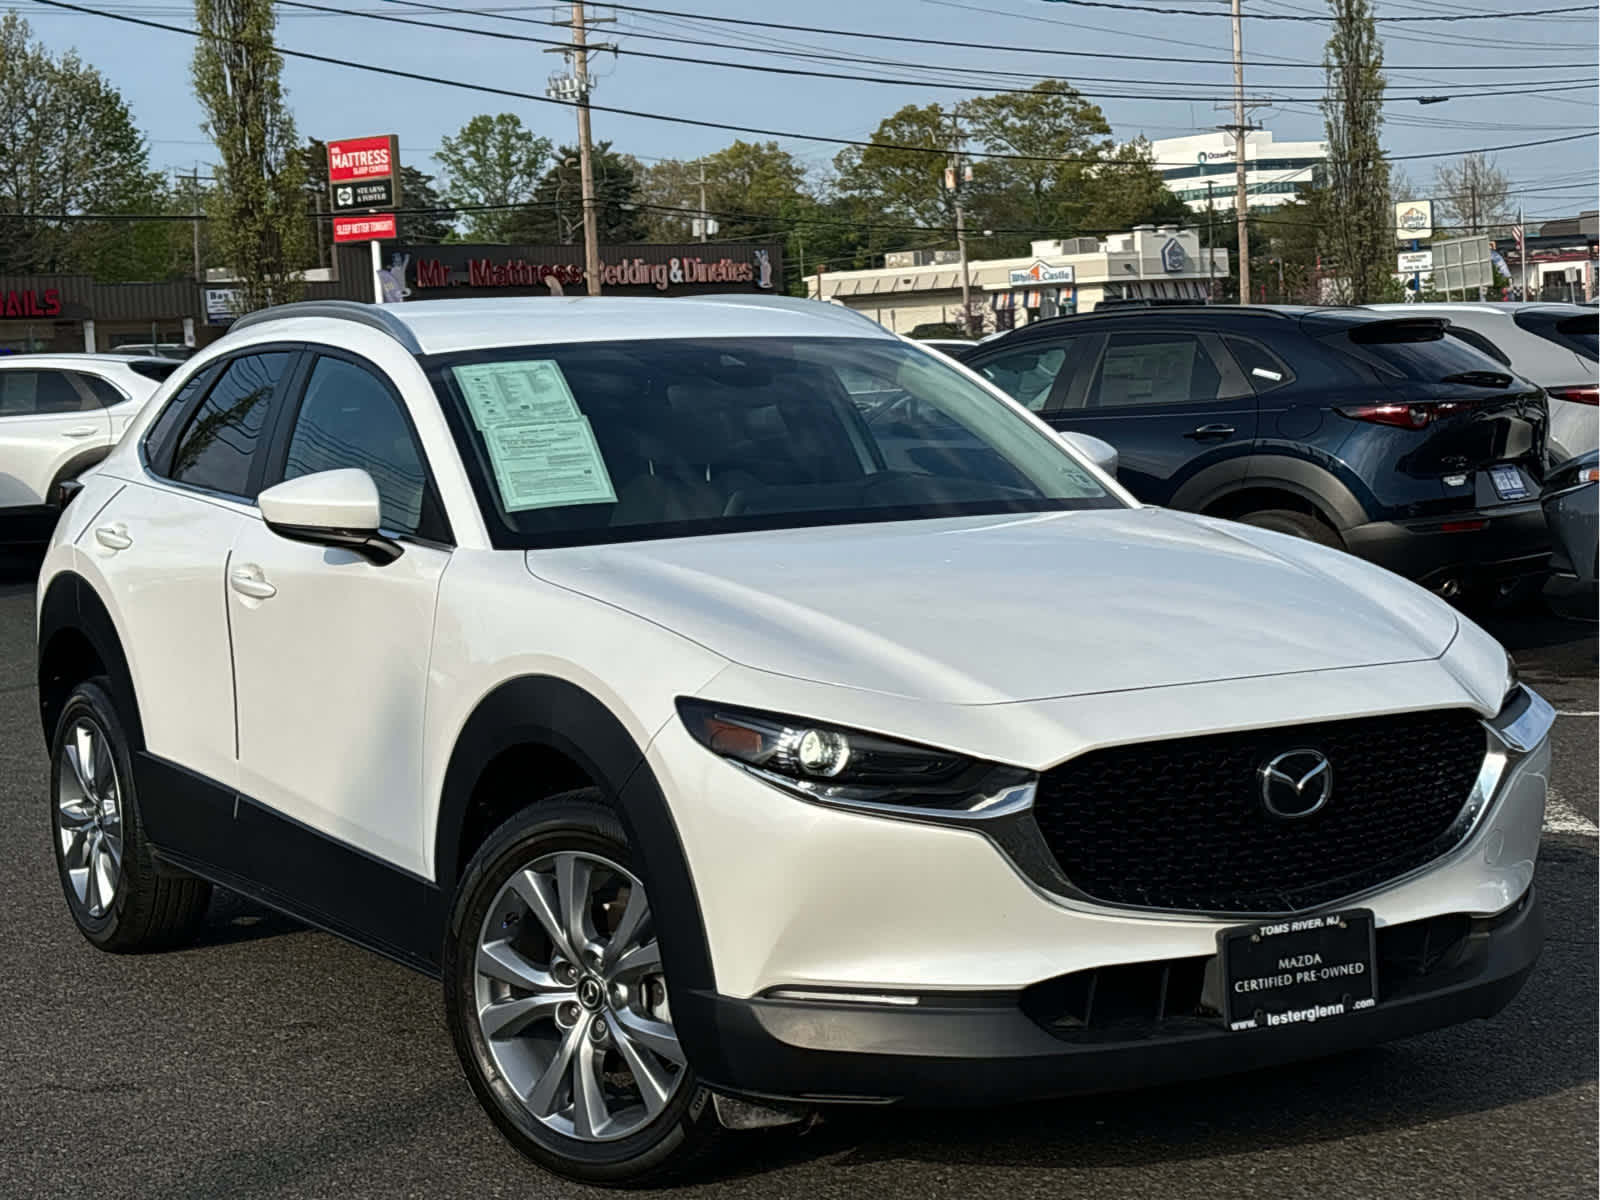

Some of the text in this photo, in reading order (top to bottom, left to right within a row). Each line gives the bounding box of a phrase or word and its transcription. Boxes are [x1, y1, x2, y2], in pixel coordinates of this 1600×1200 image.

[332, 149, 389, 169] MATTRESS
[416, 259, 461, 288] Mr.
[469, 258, 583, 287] Mattress
[669, 257, 684, 283] &
[682, 257, 753, 283] Dinettes
[0, 288, 61, 317] AILS
[1260, 923, 1289, 936] TOMS
[1326, 915, 1340, 926] NJ
[1278, 953, 1323, 970] MAZDA
[1234, 962, 1365, 993] CERTIFIED PRE-OWNED
[1267, 1003, 1344, 1026] lesterglenn
[1352, 998, 1375, 1010] .com
